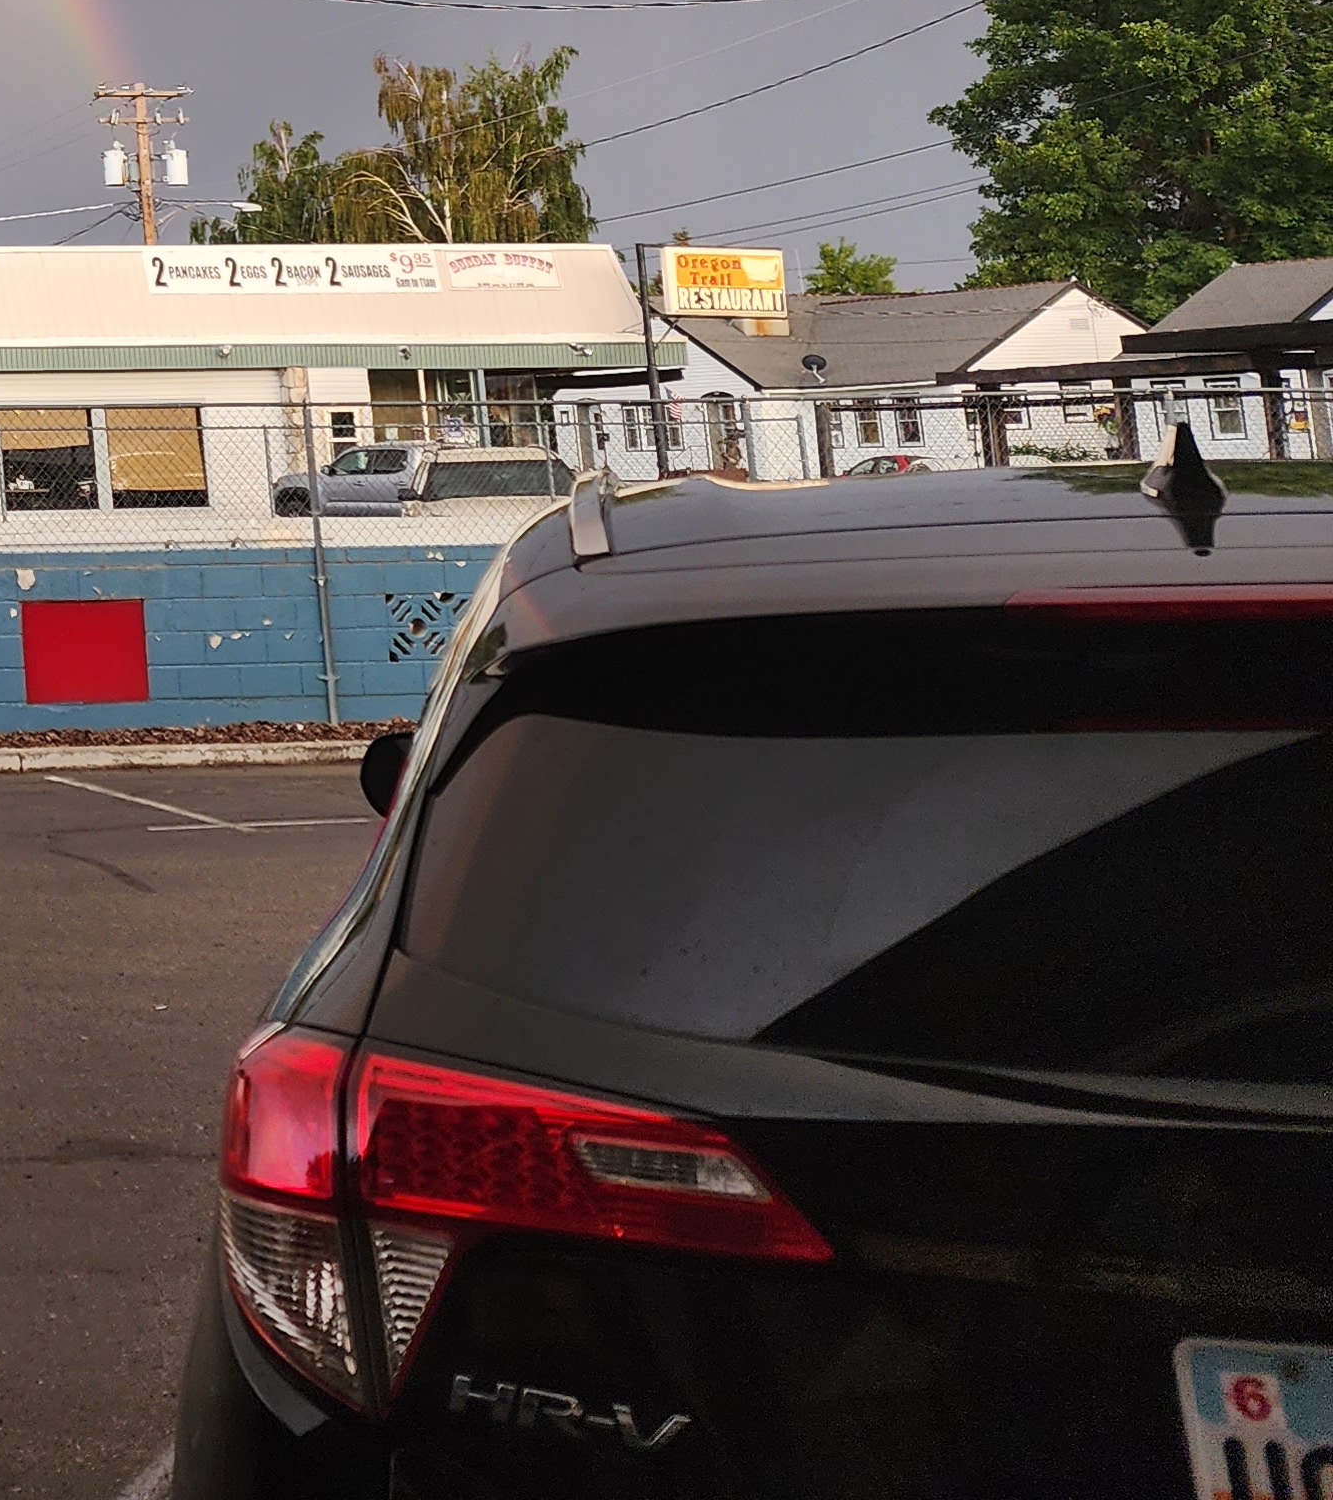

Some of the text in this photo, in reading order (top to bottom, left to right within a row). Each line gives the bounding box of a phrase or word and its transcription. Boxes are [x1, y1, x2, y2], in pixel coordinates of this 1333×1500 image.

[151, 256, 391, 288] 2 PANCAKES 2 EGGS 2 BACON 2 SAUSAGES
[448, 253, 554, 274] SUNDAY BUFFET
[676, 255, 741, 272] Oregon
[689, 272, 732, 286] Trail
[678, 287, 783, 311] RESTAURANT
[1229, 1374, 1272, 1422] 6
[449, 1374, 692, 1448] HR-V
